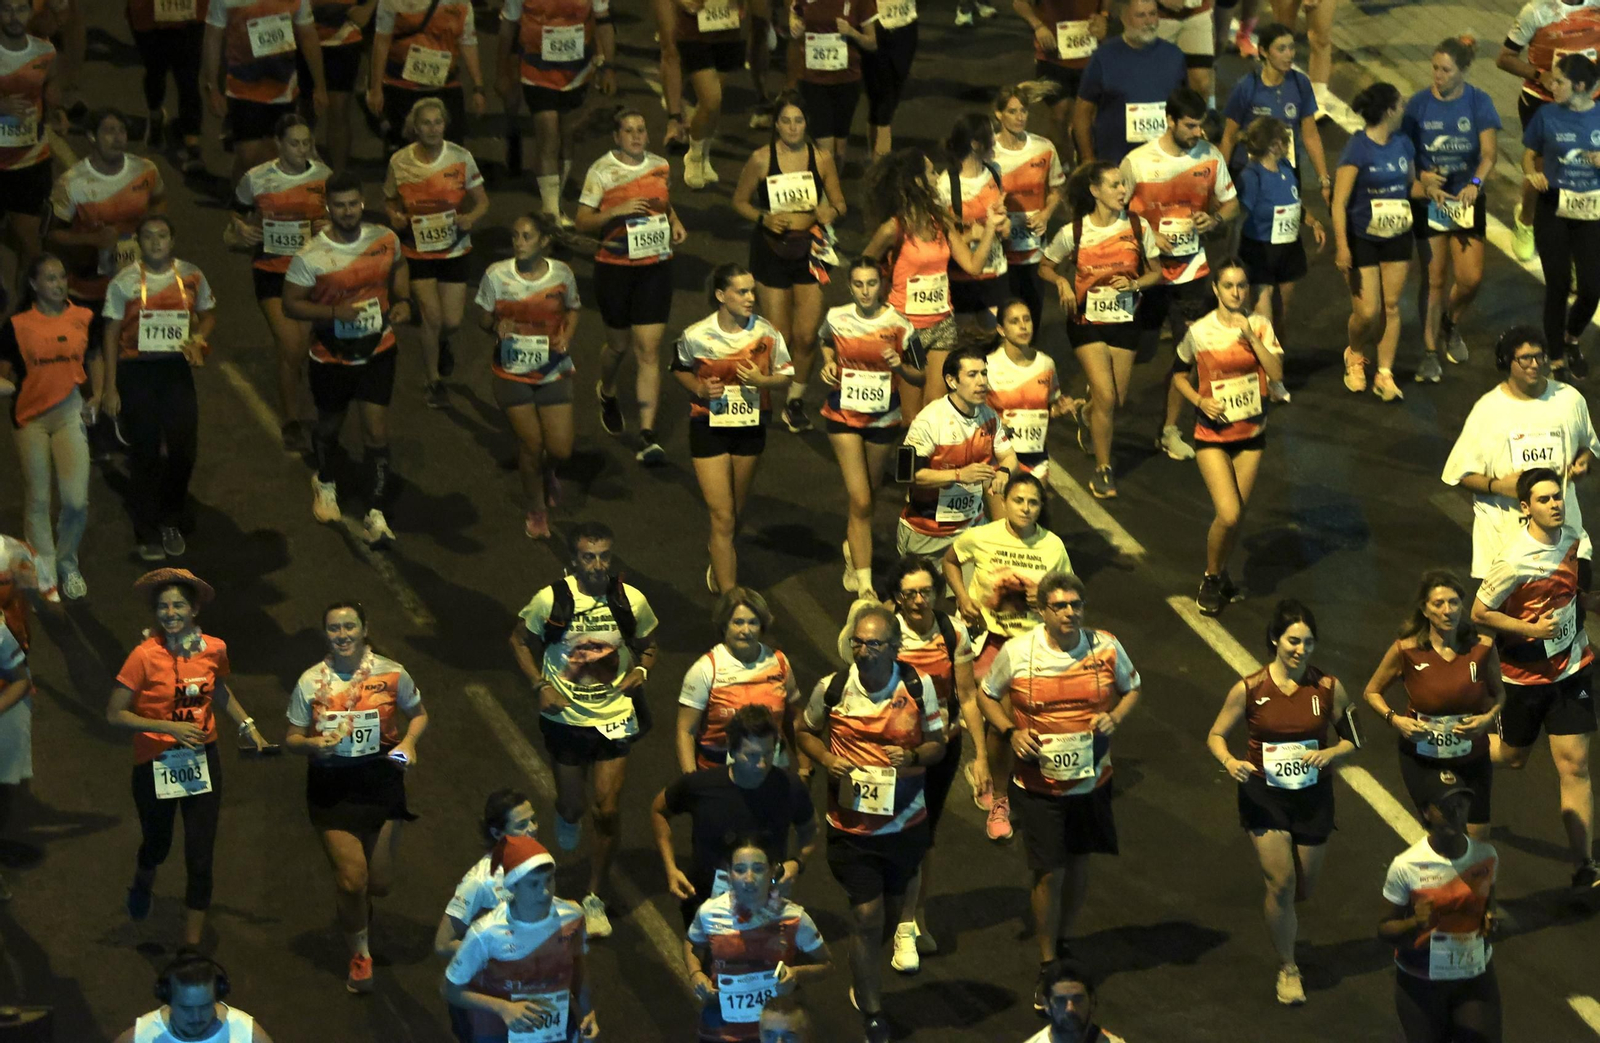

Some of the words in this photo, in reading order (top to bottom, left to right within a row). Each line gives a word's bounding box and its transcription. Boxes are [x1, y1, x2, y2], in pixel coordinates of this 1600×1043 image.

[812, 48, 838, 60] 2672
[1133, 118, 1165, 130] 15504
[774, 189, 810, 204] 11931
[270, 234, 305, 246] 14352
[634, 231, 664, 248] 15569
[913, 289, 944, 303] 19496
[1092, 300, 1126, 312] 19481
[144, 326, 182, 340] 17186
[846, 386, 884, 401] 21659
[716, 402, 754, 415] 21868
[1522, 447, 1554, 462] 6647
[946, 495, 974, 510] 4095
[1053, 752, 1080, 768] 902
[160, 766, 202, 784] 18003
